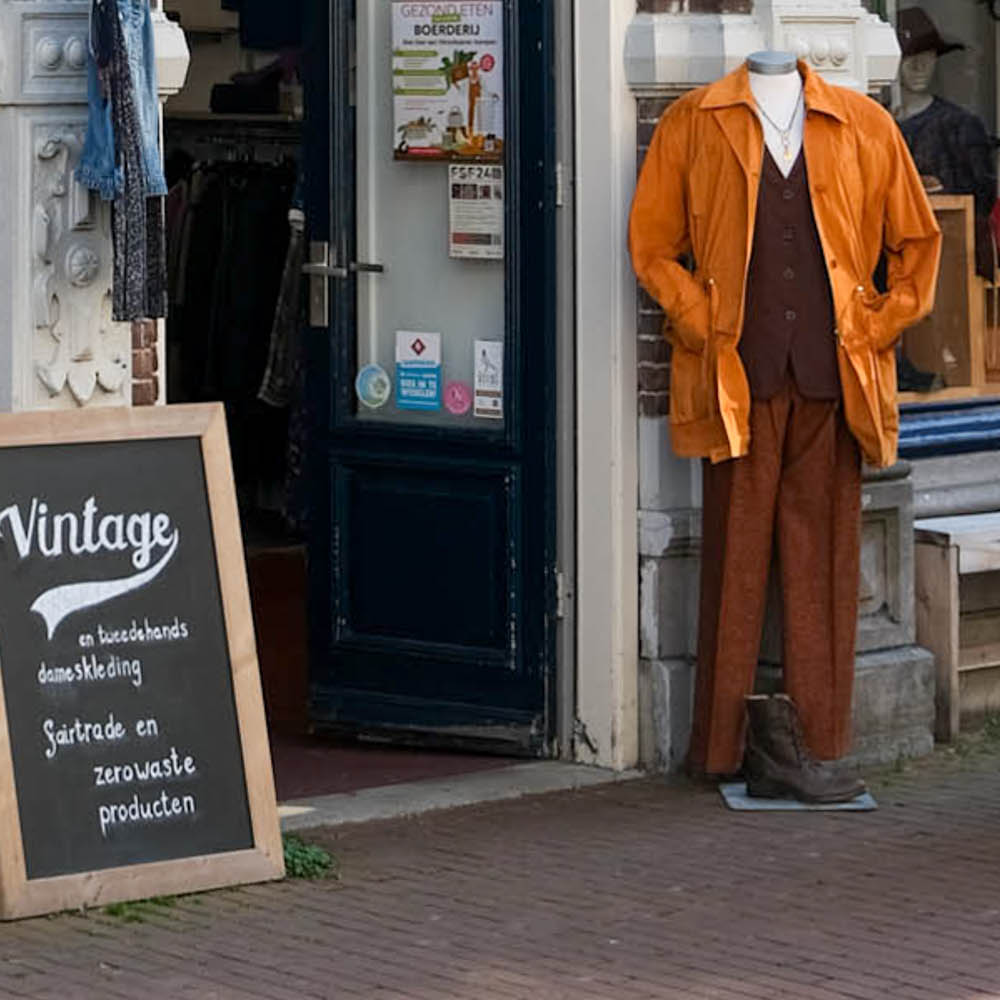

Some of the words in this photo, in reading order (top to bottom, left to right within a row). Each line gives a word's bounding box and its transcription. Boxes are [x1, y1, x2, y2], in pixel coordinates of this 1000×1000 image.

[414, 24, 480, 36] BOERDERIJ
[78, 633, 95, 648] en
[97, 617, 189, 645] tweedehands
[38, 656, 142, 687] dameskleding
[136, 716, 158, 737] en
[99, 791, 195, 837] producten
